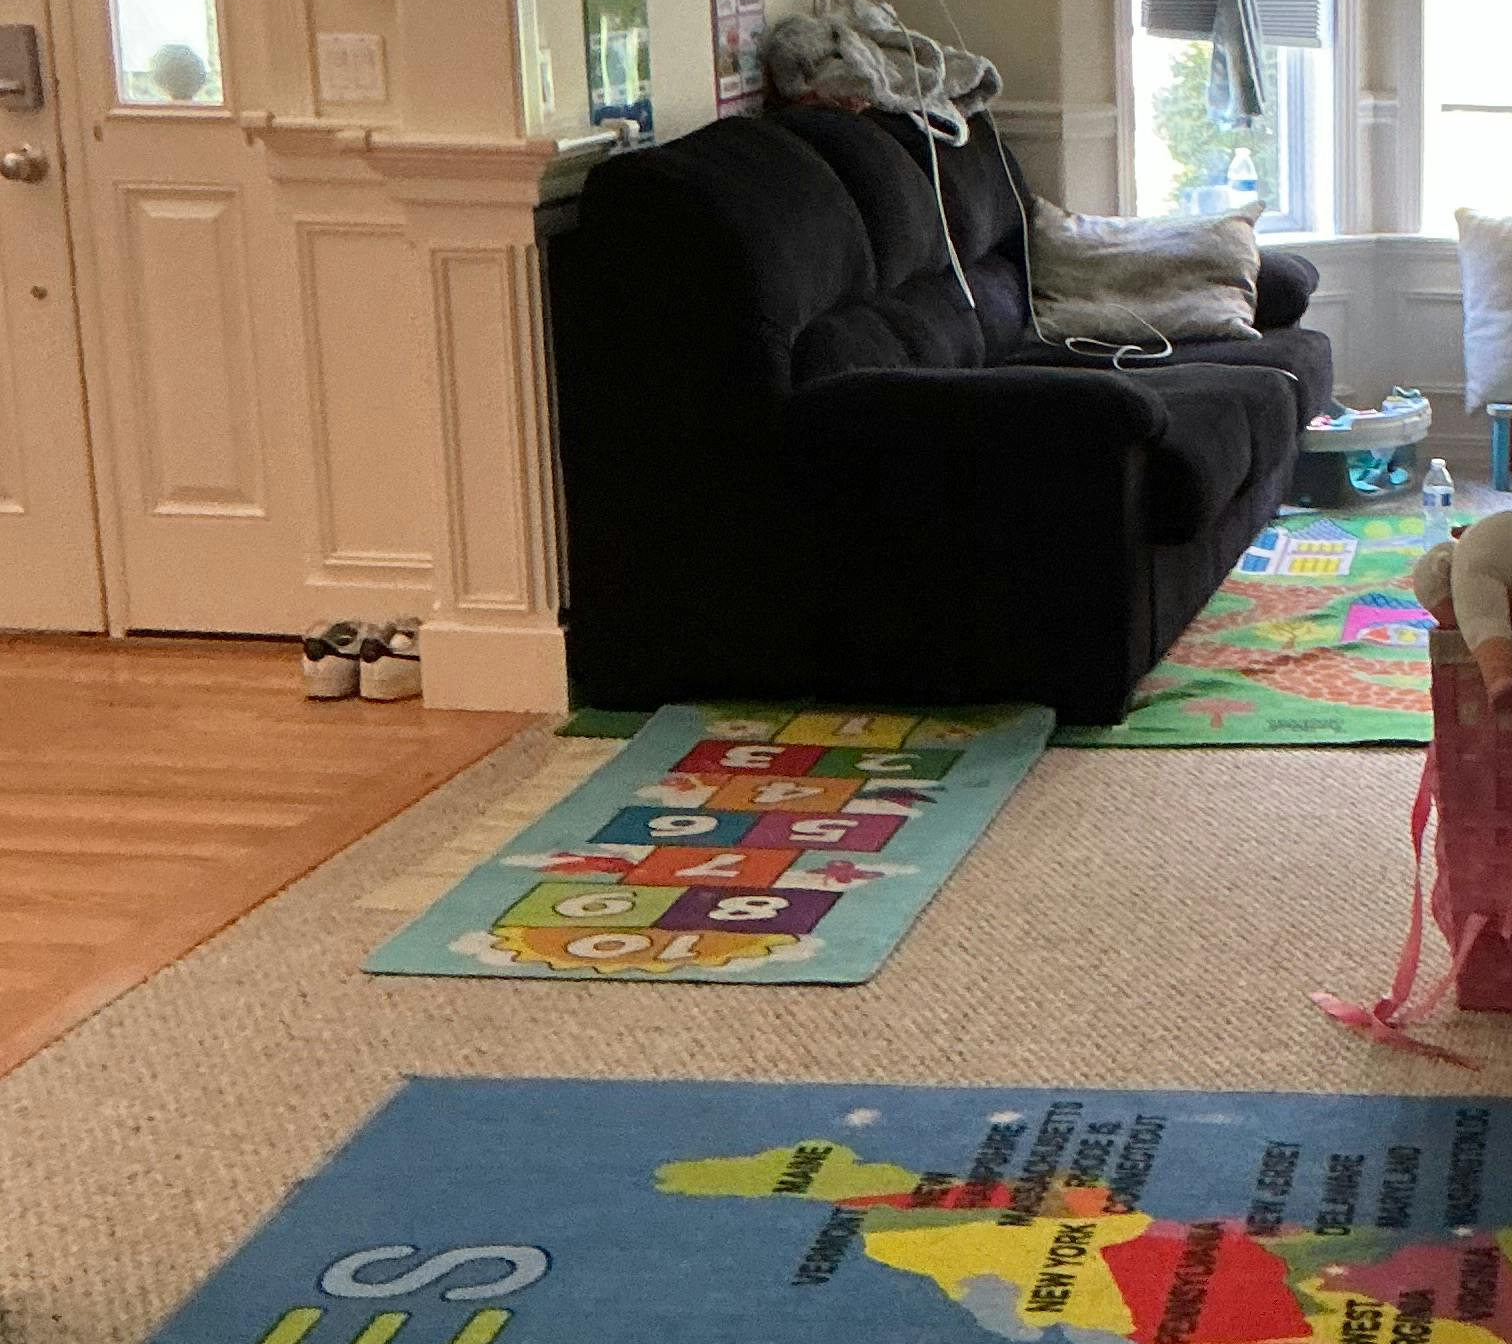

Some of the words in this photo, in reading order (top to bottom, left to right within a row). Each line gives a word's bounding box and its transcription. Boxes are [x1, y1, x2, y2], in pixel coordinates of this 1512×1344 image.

[843, 716, 878, 738] 1
[722, 746, 785, 770] 3
[861, 752, 920, 773] 2
[750, 782, 827, 806] 4
[649, 814, 719, 838] 6
[789, 819, 860, 843] 5
[675, 853, 746, 878] 7
[554, 892, 637, 919] 9
[707, 894, 791, 922] 8
[567, 932, 700, 960] 10
[772, 1145, 834, 1193] MAINE
[1257, 1138, 1301, 1196] JERSEY
[1315, 1154, 1365, 1236] DELAWARE
[792, 1207, 868, 1285] VERMONT
[1045, 1223, 1097, 1267] YORK
[1025, 1271, 1077, 1313] NEW
[1457, 1245, 1499, 1320] VIRGINIA
